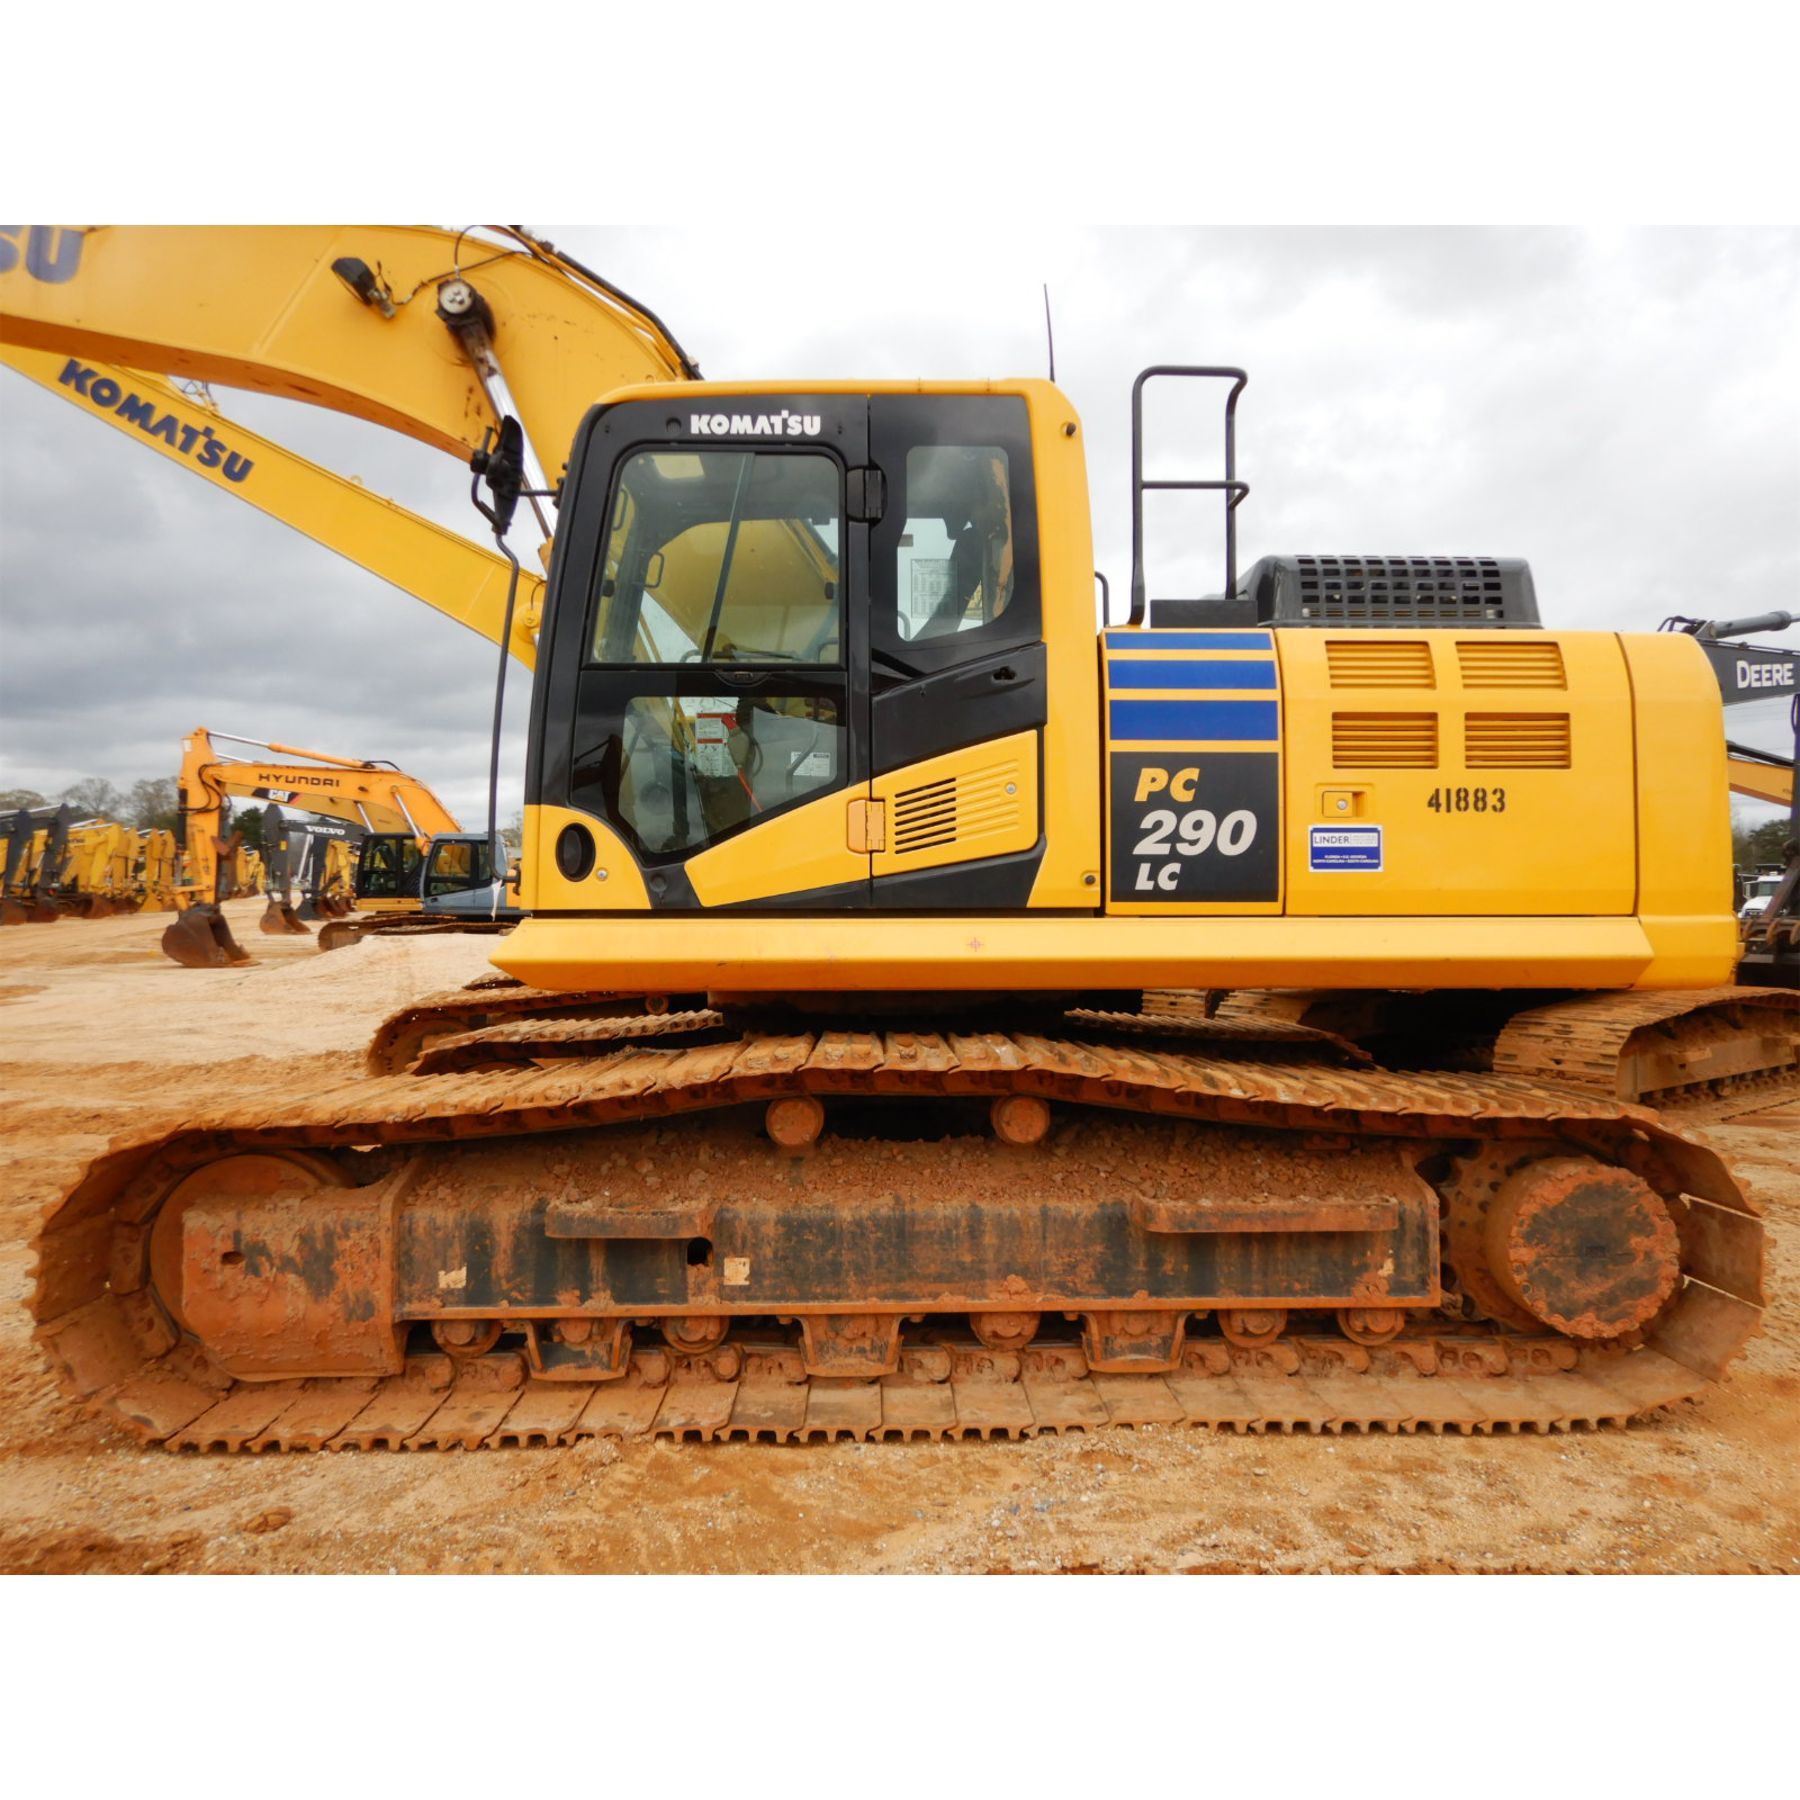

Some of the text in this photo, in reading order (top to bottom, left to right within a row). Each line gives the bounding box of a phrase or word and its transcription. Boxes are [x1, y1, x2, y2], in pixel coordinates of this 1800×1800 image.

[58, 358, 255, 484] KOMATSU
[690, 409, 821, 436] KOMATSU
[1736, 659, 1795, 689] DEERE
[258, 773, 340, 788] HYUNDAI
[1134, 767, 1200, 802] PC
[1427, 787, 1506, 814] 41883
[305, 825, 345, 836] VOLVO
[1132, 809, 1258, 856] 290
[1314, 835, 1350, 845] LINDER
[1134, 862, 1182, 891] LC
